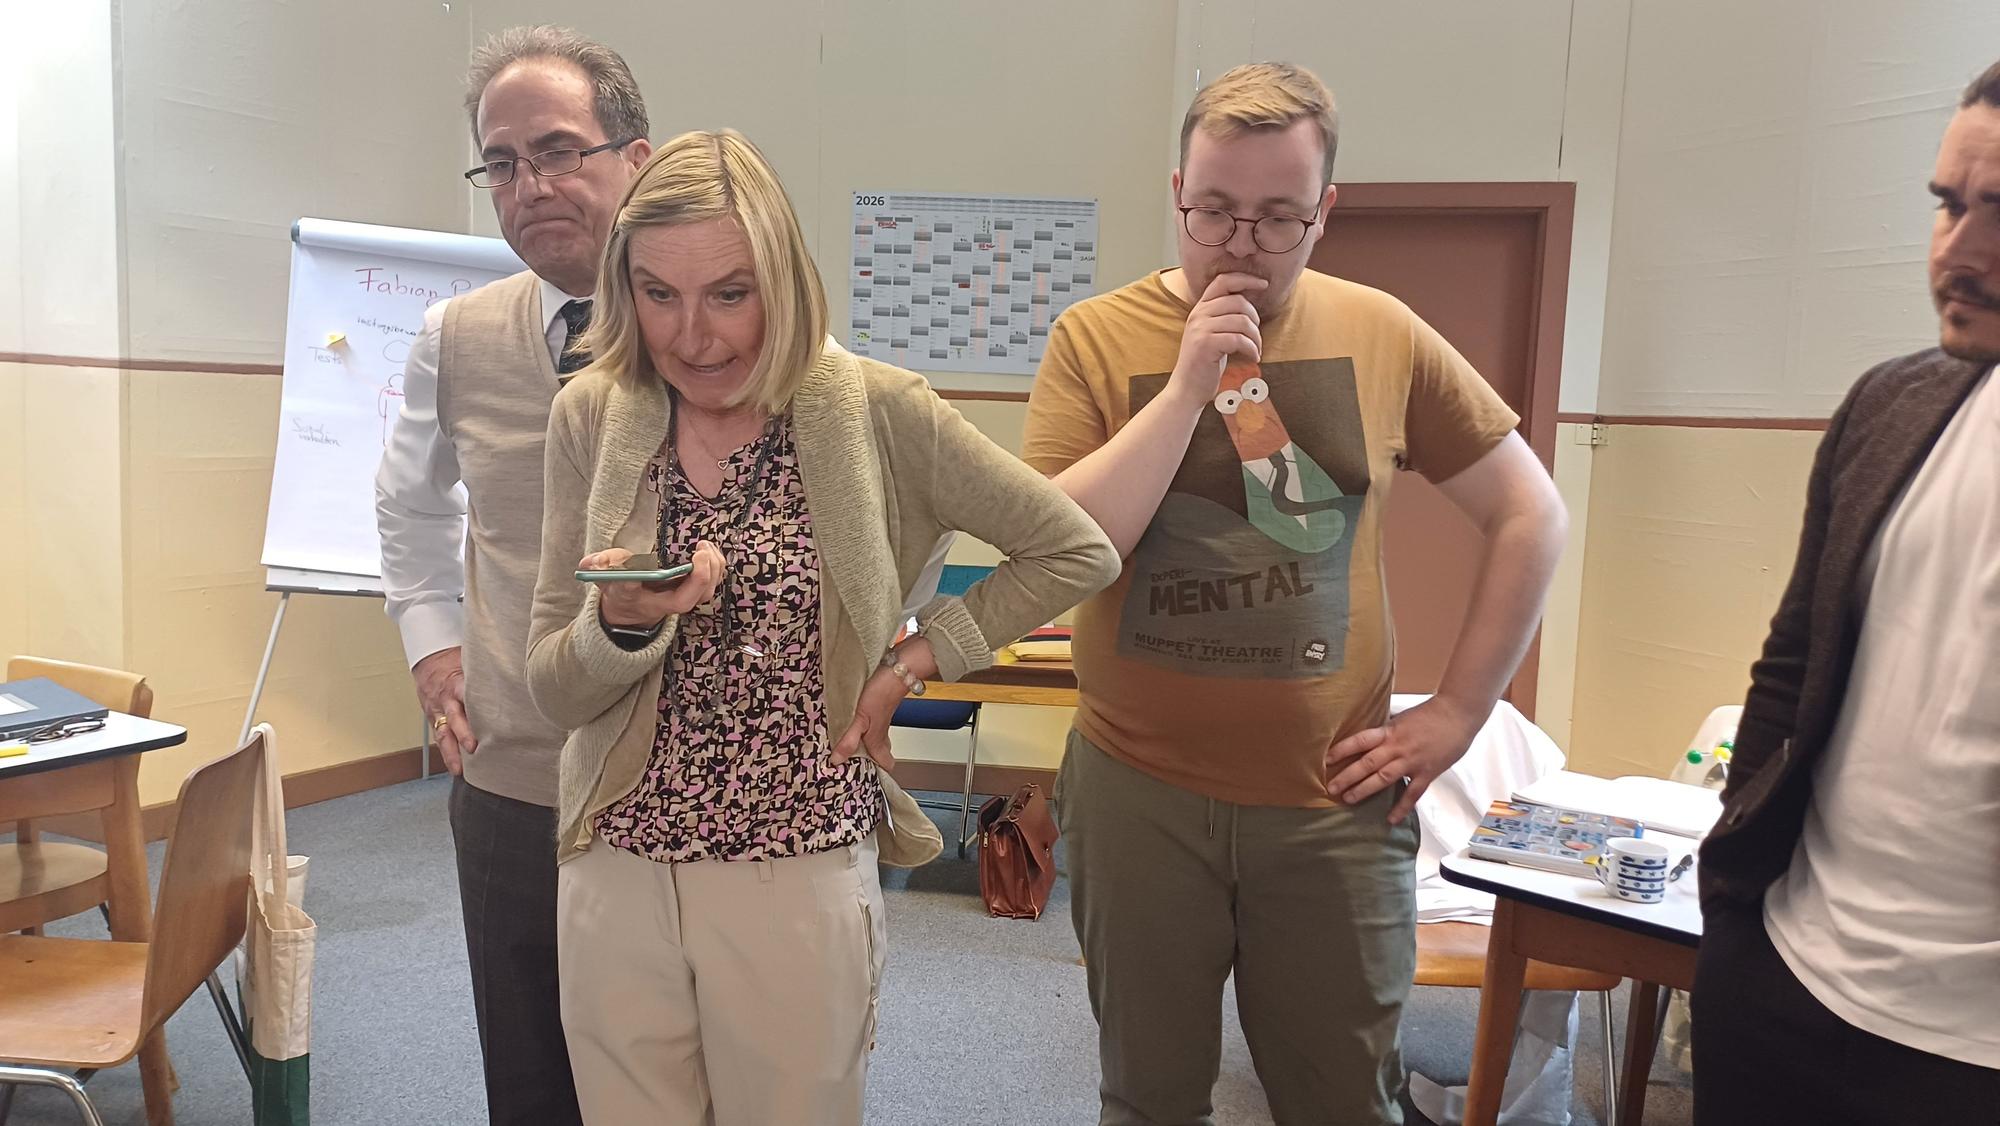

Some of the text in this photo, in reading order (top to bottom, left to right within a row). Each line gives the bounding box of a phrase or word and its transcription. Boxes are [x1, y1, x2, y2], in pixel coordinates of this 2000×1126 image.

[856, 195, 885, 206] 2026
[354, 266, 441, 302] Fabian
[1149, 561, 1314, 617] MENTAL
[1135, 632, 1284, 658] MUPPET THEATRE
